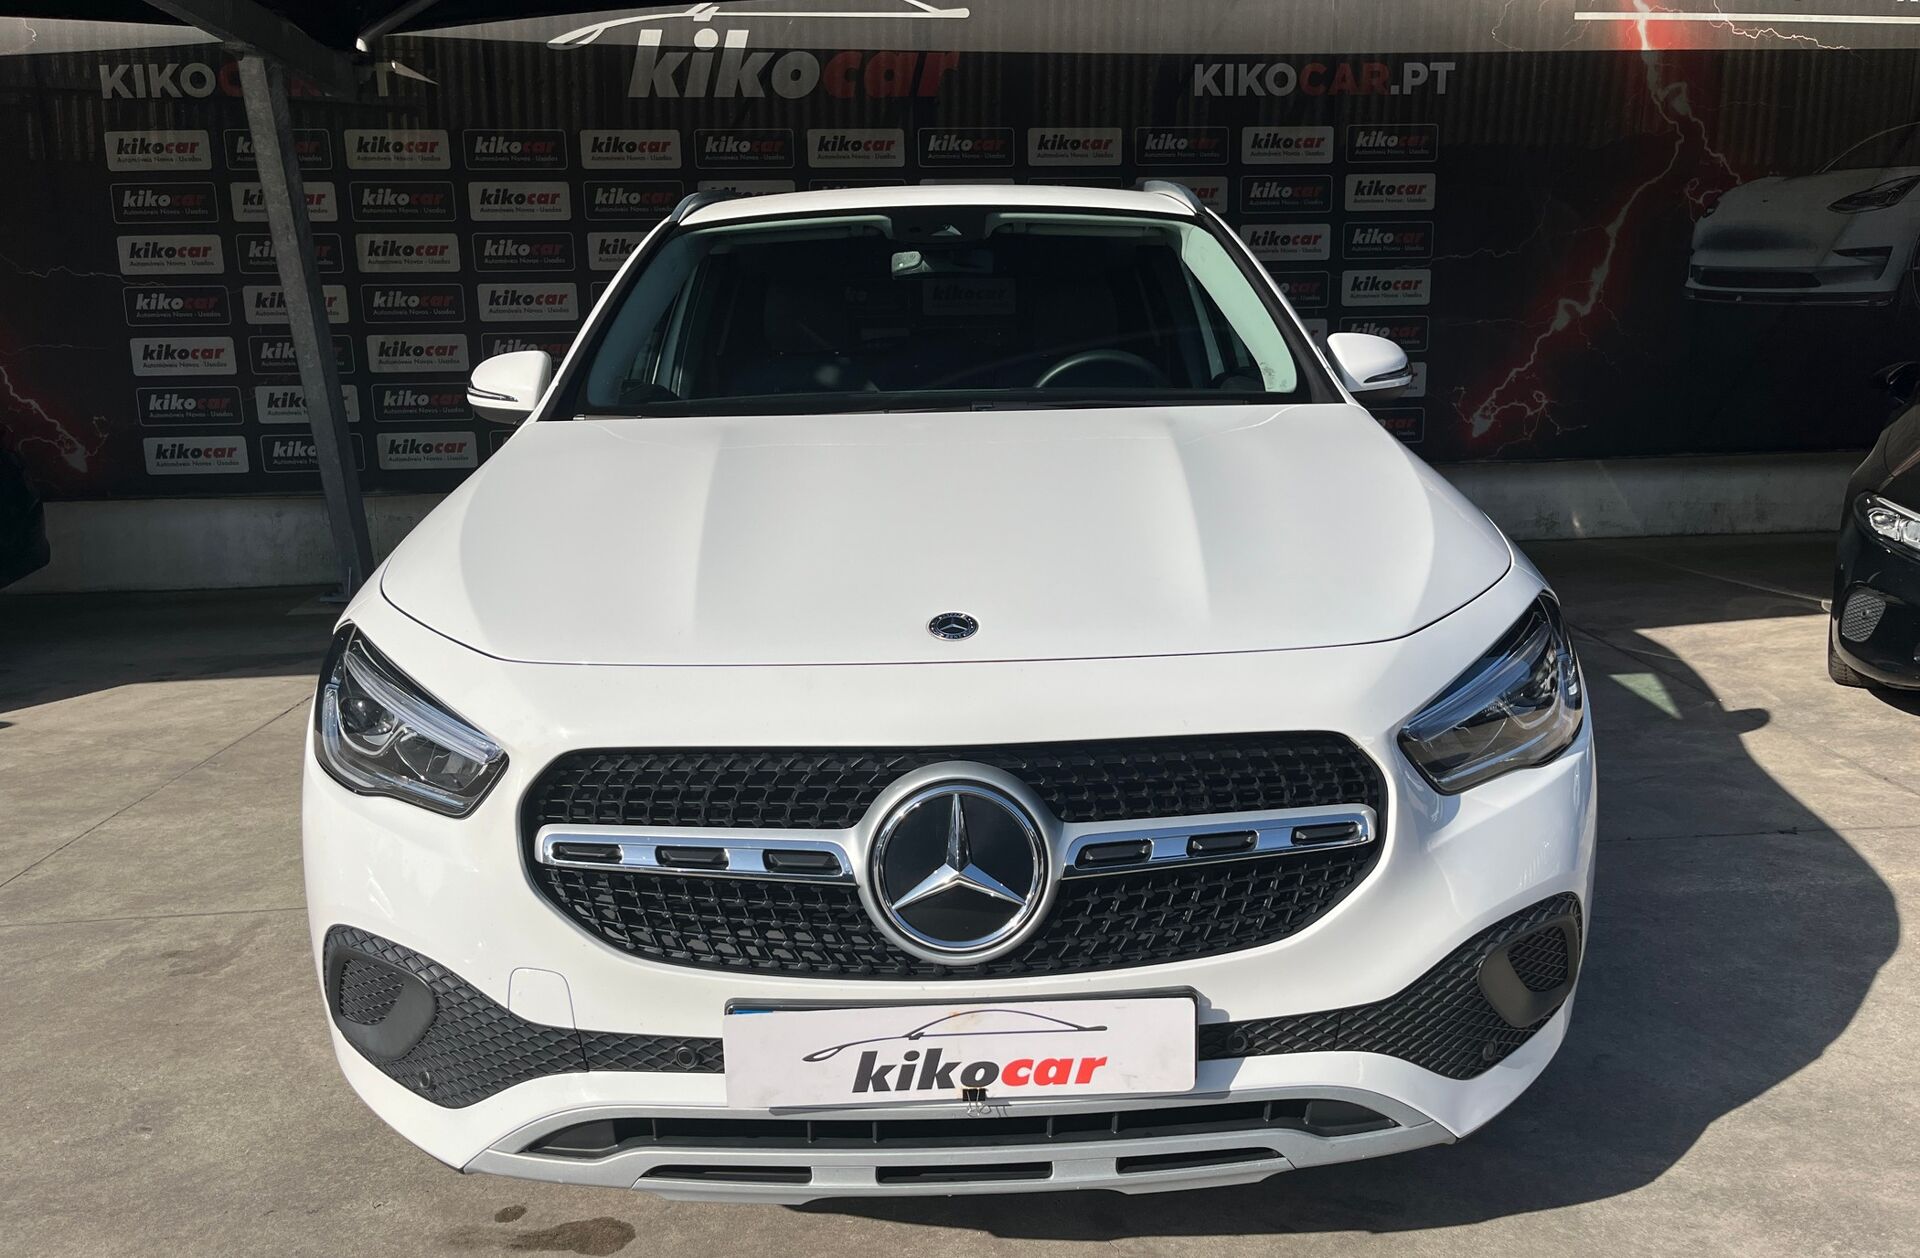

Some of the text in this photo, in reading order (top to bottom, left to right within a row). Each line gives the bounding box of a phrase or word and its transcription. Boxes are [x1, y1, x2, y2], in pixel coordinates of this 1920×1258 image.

[627, 28, 960, 99] kikocar
[1194, 62, 1456, 97] KIKOCAR.PT
[117, 137, 200, 154] kikocar
[357, 137, 438, 153] kikocar
[476, 137, 556, 153] kikocar
[592, 137, 671, 153] kikocar
[706, 136, 784, 152] kikocar
[818, 136, 895, 152] kikocar
[929, 135, 1005, 151] kikocar
[1038, 135, 1113, 150] kikocar
[1146, 134, 1219, 150] kikocar
[1252, 133, 1324, 149] kikocar
[1357, 132, 1428, 147] kikocar
[595, 188, 674, 204] kikocar
[1251, 183, 1323, 198] kikocar
[1355, 181, 1426, 196] kikocar
[123, 190, 206, 207] kikocar
[363, 189, 444, 205] kikocar
[480, 189, 560, 205] kikocar
[1250, 231, 1322, 246] kikocar
[1353, 229, 1424, 244] kikocar
[130, 242, 212, 258] kikocar
[368, 241, 448, 257] kikocar
[485, 240, 564, 256] kikocar
[1351, 277, 1422, 291] kikocar
[136, 294, 218, 310] kikocar
[374, 292, 453, 307] kikocar
[489, 290, 568, 306] kikocar
[143, 344, 224, 360] kikocar
[379, 342, 458, 357] kikocar
[150, 395, 230, 410] kikocar
[384, 391, 462, 406] kikocar
[156, 444, 236, 460] kikocar
[389, 440, 467, 455] kikocar
[852, 1048, 1108, 1093] kikocar
